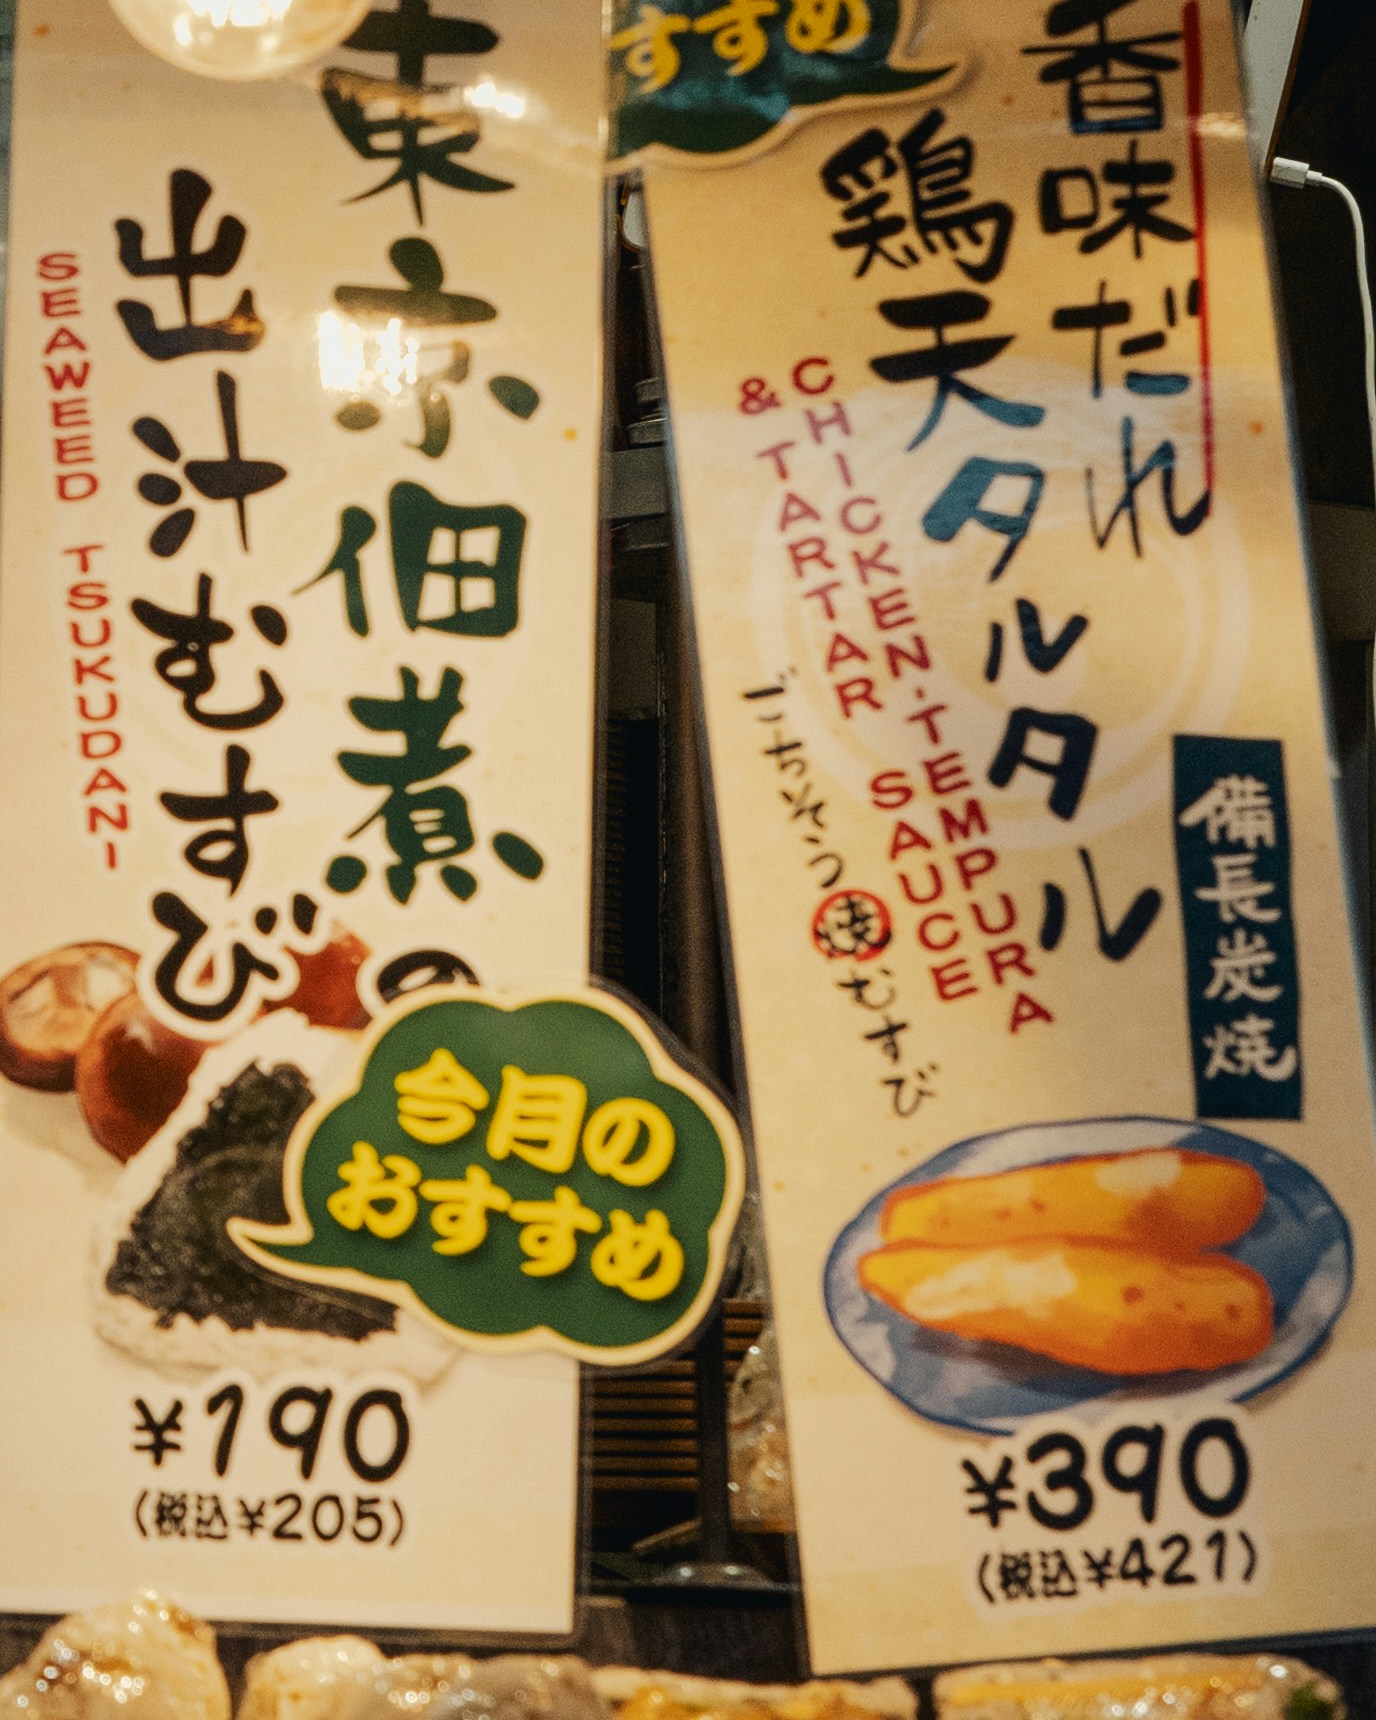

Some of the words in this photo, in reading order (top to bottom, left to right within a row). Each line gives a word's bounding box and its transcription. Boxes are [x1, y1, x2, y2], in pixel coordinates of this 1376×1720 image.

[36, 249, 98, 501] SEAWEED
[739, 376, 782, 417] &
[113, 168, 320, 1022] 出汁むすび
[756, 439, 886, 720] TARTAR
[821, 109, 1163, 964] 鶏天タルタル
[62, 544, 130, 870] TSUKUDANI
[870, 769, 979, 1004] SAUCE
[1180, 773, 1297, 1082] 備長炭焼
[394, 1047, 677, 1187] 今月の
[326, 1141, 686, 1301] おすすめ
[131, 1382, 412, 1483] ¥190
[134, 1489, 406, 1548] (税込¥205)
[959, 1417, 1252, 1532] ¥390
[977, 1530, 1260, 1603] (税込¥421)
